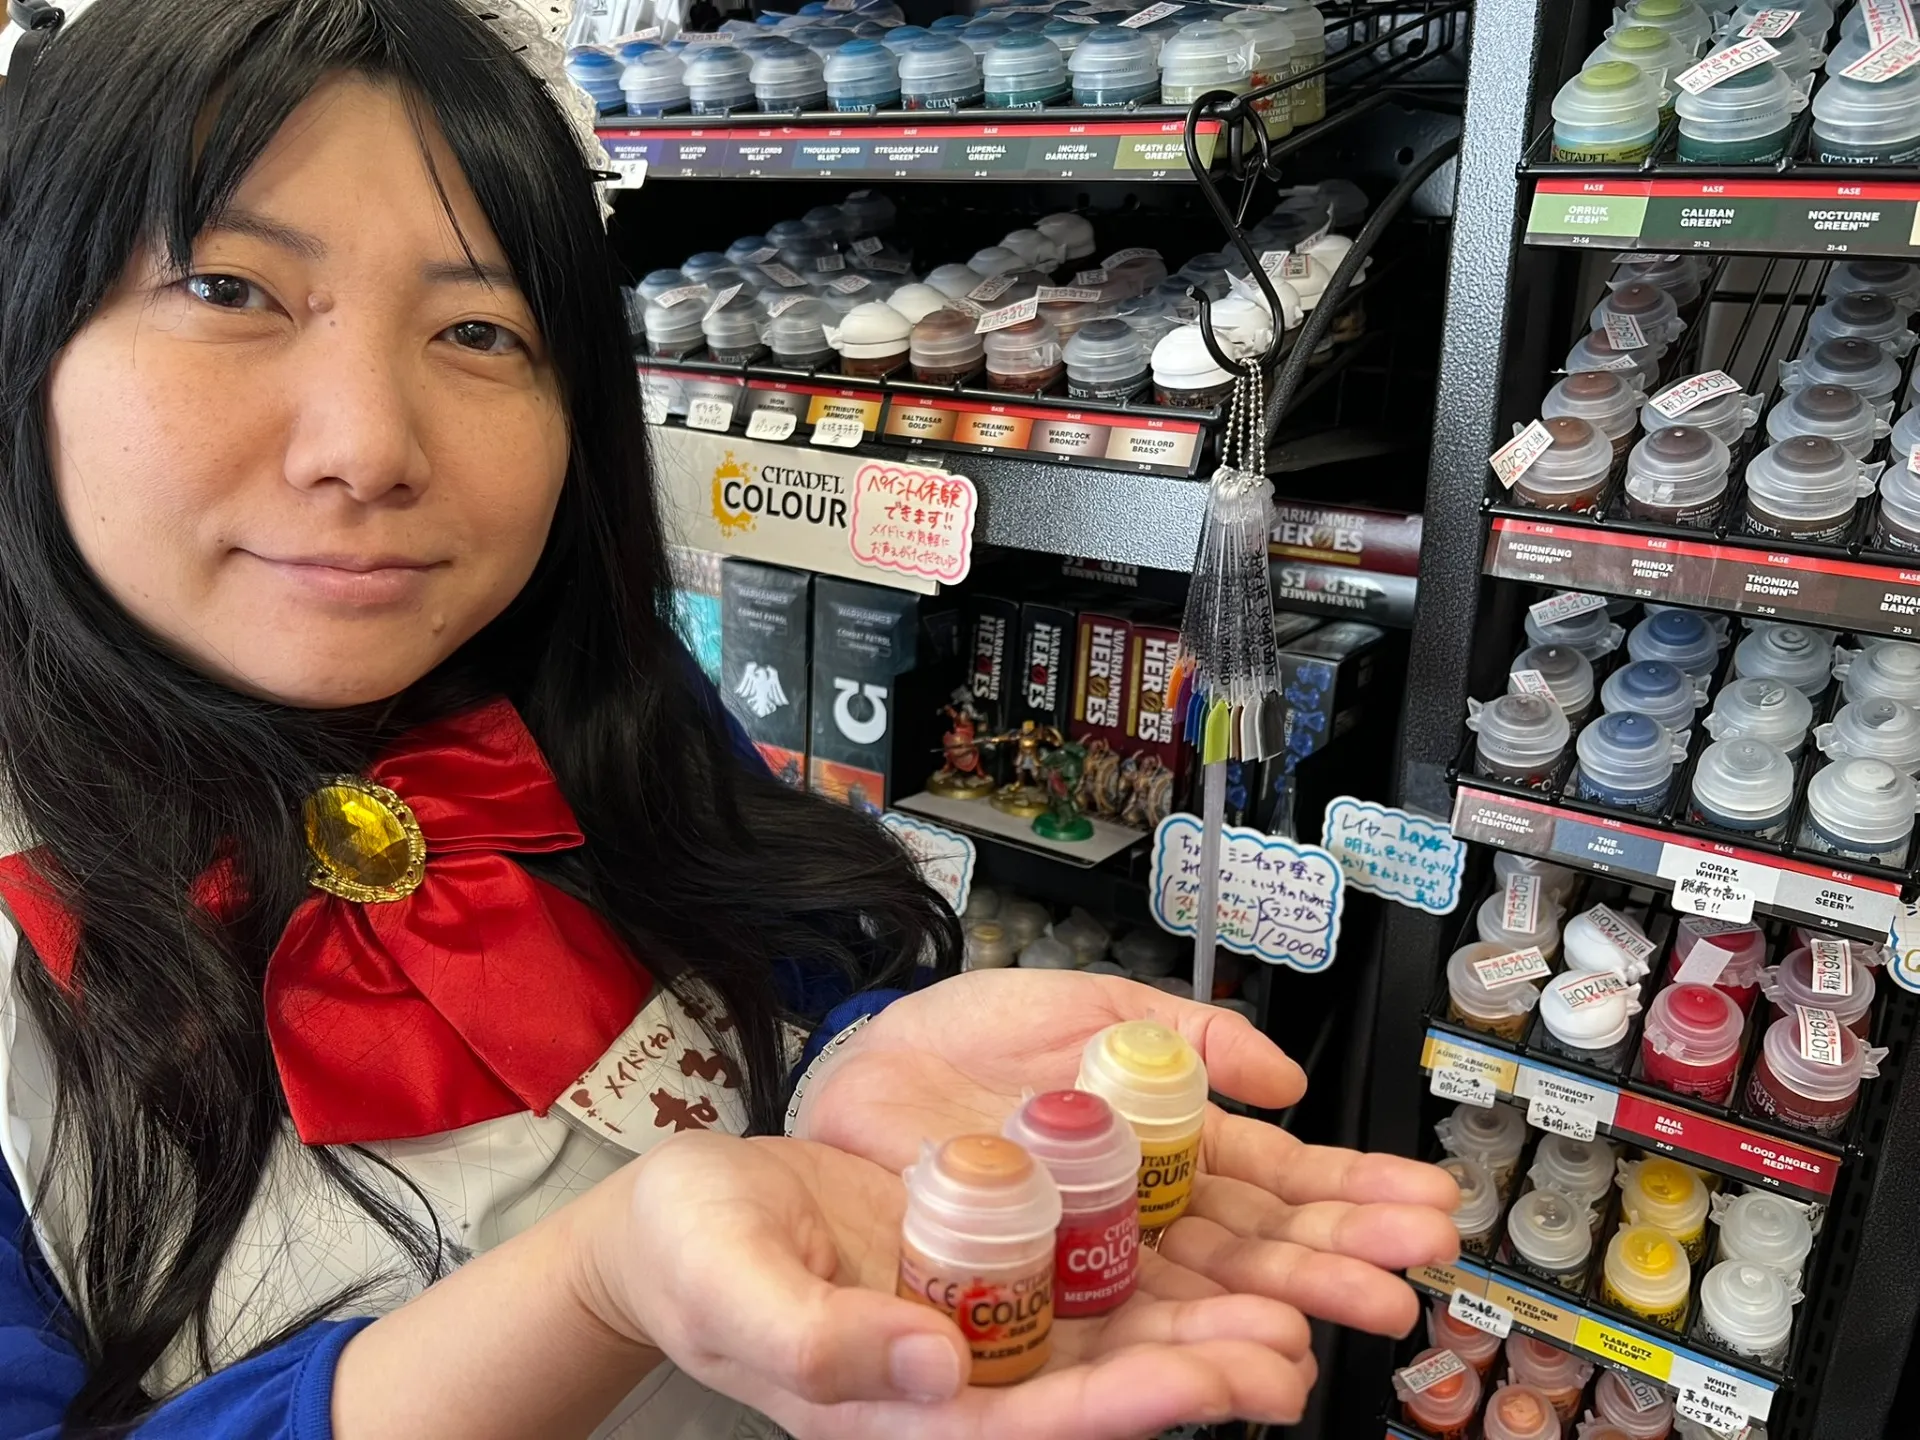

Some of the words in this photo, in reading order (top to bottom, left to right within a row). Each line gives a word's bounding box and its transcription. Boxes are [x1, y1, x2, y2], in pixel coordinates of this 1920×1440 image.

[874, 146, 912, 154] STEGADON
[914, 146, 939, 154] SCALE
[967, 146, 1007, 154] LUPERCAL
[1058, 145, 1088, 153] INCUBI
[1134, 144, 1163, 152] DEATH
[1583, 184, 1604, 192] BASE
[1702, 185, 1724, 193] BASE
[1837, 187, 1861, 196] BASE
[1568, 205, 1609, 216] ORRUK
[1681, 207, 1735, 219] CALIBAN
[1807, 210, 1881, 222] NOCTURNE
[1564, 214, 1609, 225] FLESH™
[1680, 217, 1732, 228] GREEN™
[1814, 220, 1869, 231] GREEN™
[1572, 236, 1590, 244] 21-56
[1693, 240, 1711, 248] 21-12
[1661, 376, 1734, 414] 税込540円
[823, 404, 865, 415] RETRIBUTOR
[902, 414, 942, 424] BALTHASAR
[972, 421, 1015, 432] SCREAMING
[1049, 429, 1091, 440] WARPLOCK
[1130, 438, 1175, 448] RUNELORD
[761, 465, 845, 495] CITADEL
[868, 475, 963, 508] ペイント体験
[724, 481, 847, 528] COLOUR
[1535, 525, 1554, 534] BASE
[1508, 543, 1572, 558] MOURNFANG
[1647, 540, 1667, 549] BASE
[1516, 551, 1562, 565] BROWN™
[1768, 555, 1790, 564] BASE
[1631, 559, 1675, 573] RHINOX
[1633, 568, 1669, 579] HIDE™
[1747, 574, 1800, 589] THONDIA
[1744, 583, 1800, 597] BROWN™
[1280, 587, 1366, 610] WARHAMMER
[1044, 626, 1062, 711] WARHAMMER
[1105, 628, 1126, 728] WARHAMMER
[1477, 808, 1530, 827] CATACHAN
[1588, 842, 1624, 856] FANG™
[1597, 836, 1618, 848] THE
[1714, 844, 1734, 854] BASE
[1695, 868, 1739, 883] WHITE™
[1700, 861, 1738, 876] CORAX
[1831, 870, 1853, 880] BASE
[1821, 888, 1853, 904] GREY
[1814, 896, 1855, 911] SEER™
[1269, 901, 1322, 924] ランダム
[1587, 909, 1646, 957] 税込740円
[1482, 953, 1546, 981] 税込540円
[1464, 1056, 1502, 1074] ARMOUR
[1537, 1079, 1595, 1102] STORMHOST
[1544, 1089, 1585, 1105] SILVER™
[1657, 1115, 1684, 1130] BAAL
[1654, 1123, 1684, 1137] RED™
[1740, 1142, 1781, 1163] BLOOD
[1781, 1153, 1822, 1174] ANGELS
[1762, 1156, 1794, 1172] RED™
[1103, 1258, 1129, 1280] BASE
[1506, 1295, 1540, 1314] FLAYED
[1540, 1308, 1559, 1321] ONE
[1600, 1332, 1629, 1351] FLASH
[1630, 1344, 1652, 1359] GITZ
[1603, 1341, 1647, 1362] YELLOW™
[1704, 1383, 1737, 1398] SCAR™
[1706, 1376, 1738, 1393] WHITE
